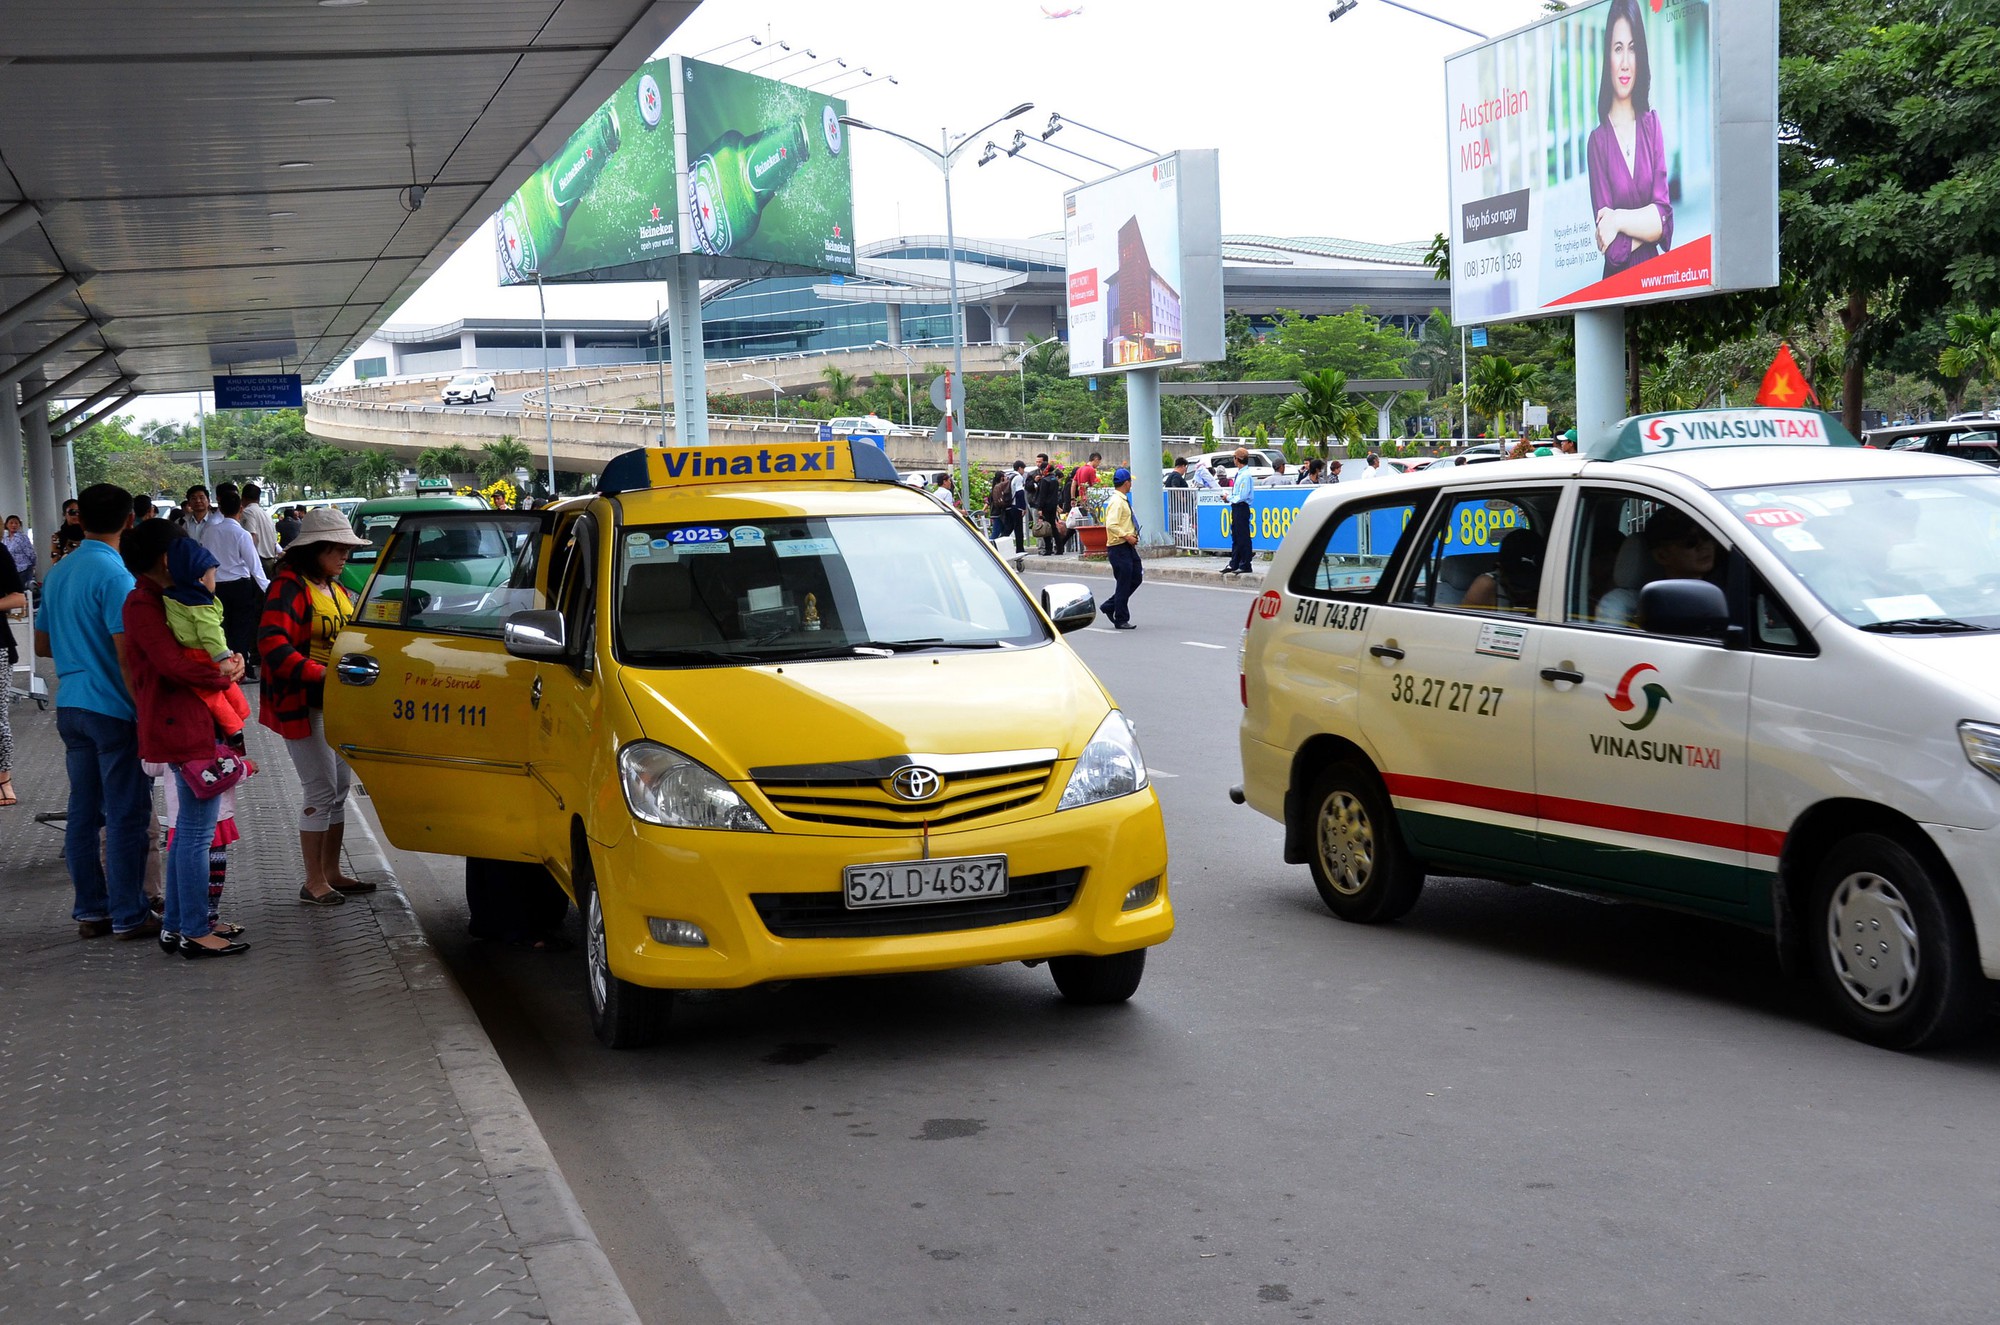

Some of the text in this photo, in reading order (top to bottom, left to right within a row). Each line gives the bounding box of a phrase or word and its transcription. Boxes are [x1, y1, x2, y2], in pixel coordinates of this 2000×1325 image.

[1460, 88, 1527, 131] Australian
[754, 152, 780, 178] Heineken
[1461, 138, 1491, 172] MBA
[559, 155, 586, 191] Heineken
[1466, 214, 1480, 231] Nộp
[1491, 211, 1499, 224] sơ
[1500, 208, 1517, 225] ngay
[639, 223, 674, 239] Heineken
[652, 240, 661, 250] your
[662, 237, 674, 247] world
[824, 239, 851, 253] Heineken
[1580, 237, 1592, 247] MBA
[1464, 252, 1522, 280] (08) 3776 1369
[1585, 251, 1598, 263] 2009
[1641, 268, 1709, 288] www.rmit.edu.vn
[662, 446, 835, 478] Vinataxi
[418, 479, 448, 487] TAXI
[1745, 510, 1807, 525] 7071
[672, 528, 723, 542] 2025
[1259, 596, 1280, 616] 7071
[1294, 598, 1370, 631] 51A 743.81
[445, 676, 481, 690] Service
[1391, 673, 1504, 717] 38.27 27 27
[393, 698, 486, 727] 38 111 111
[850, 862, 1003, 902] 52LD-4637
